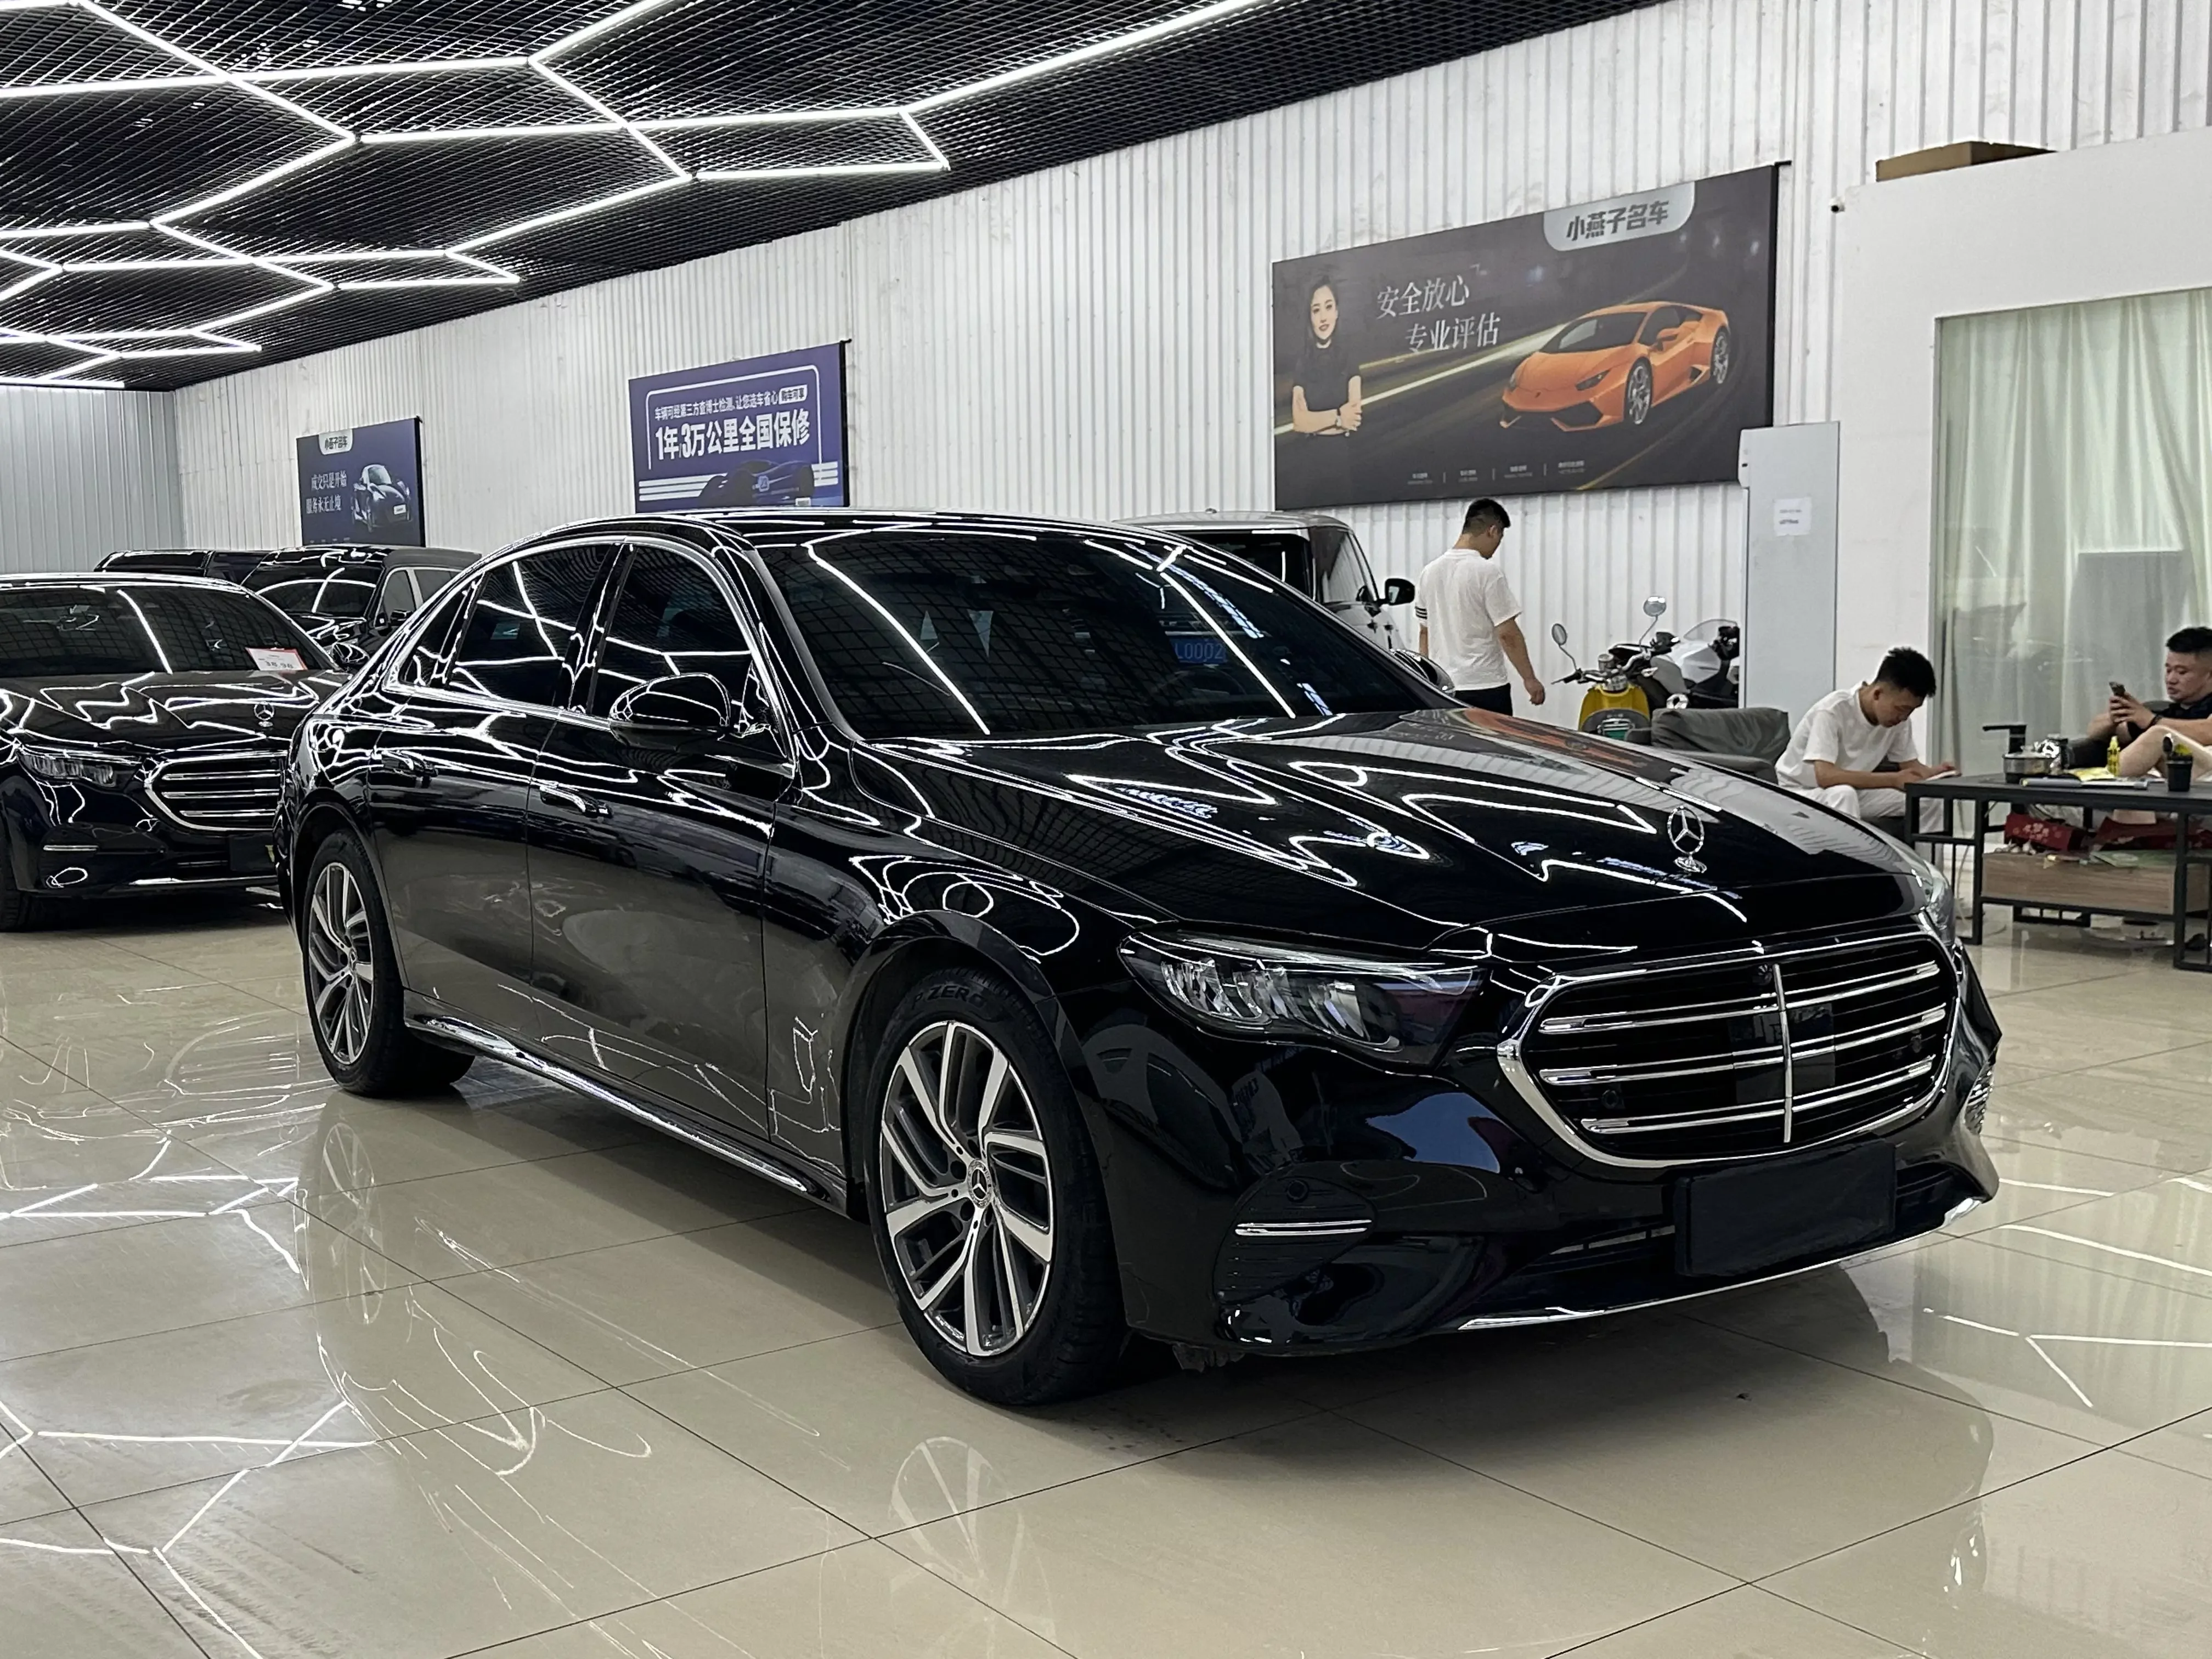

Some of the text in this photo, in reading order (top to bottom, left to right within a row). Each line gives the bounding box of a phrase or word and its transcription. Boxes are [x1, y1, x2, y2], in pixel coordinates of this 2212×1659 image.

[1566, 201, 1669, 241] 小燕子名车
[1376, 275, 1470, 319] 安全放心
[1406, 312, 1500, 352] 专业评估
[927, 985, 986, 1008] ZERO
